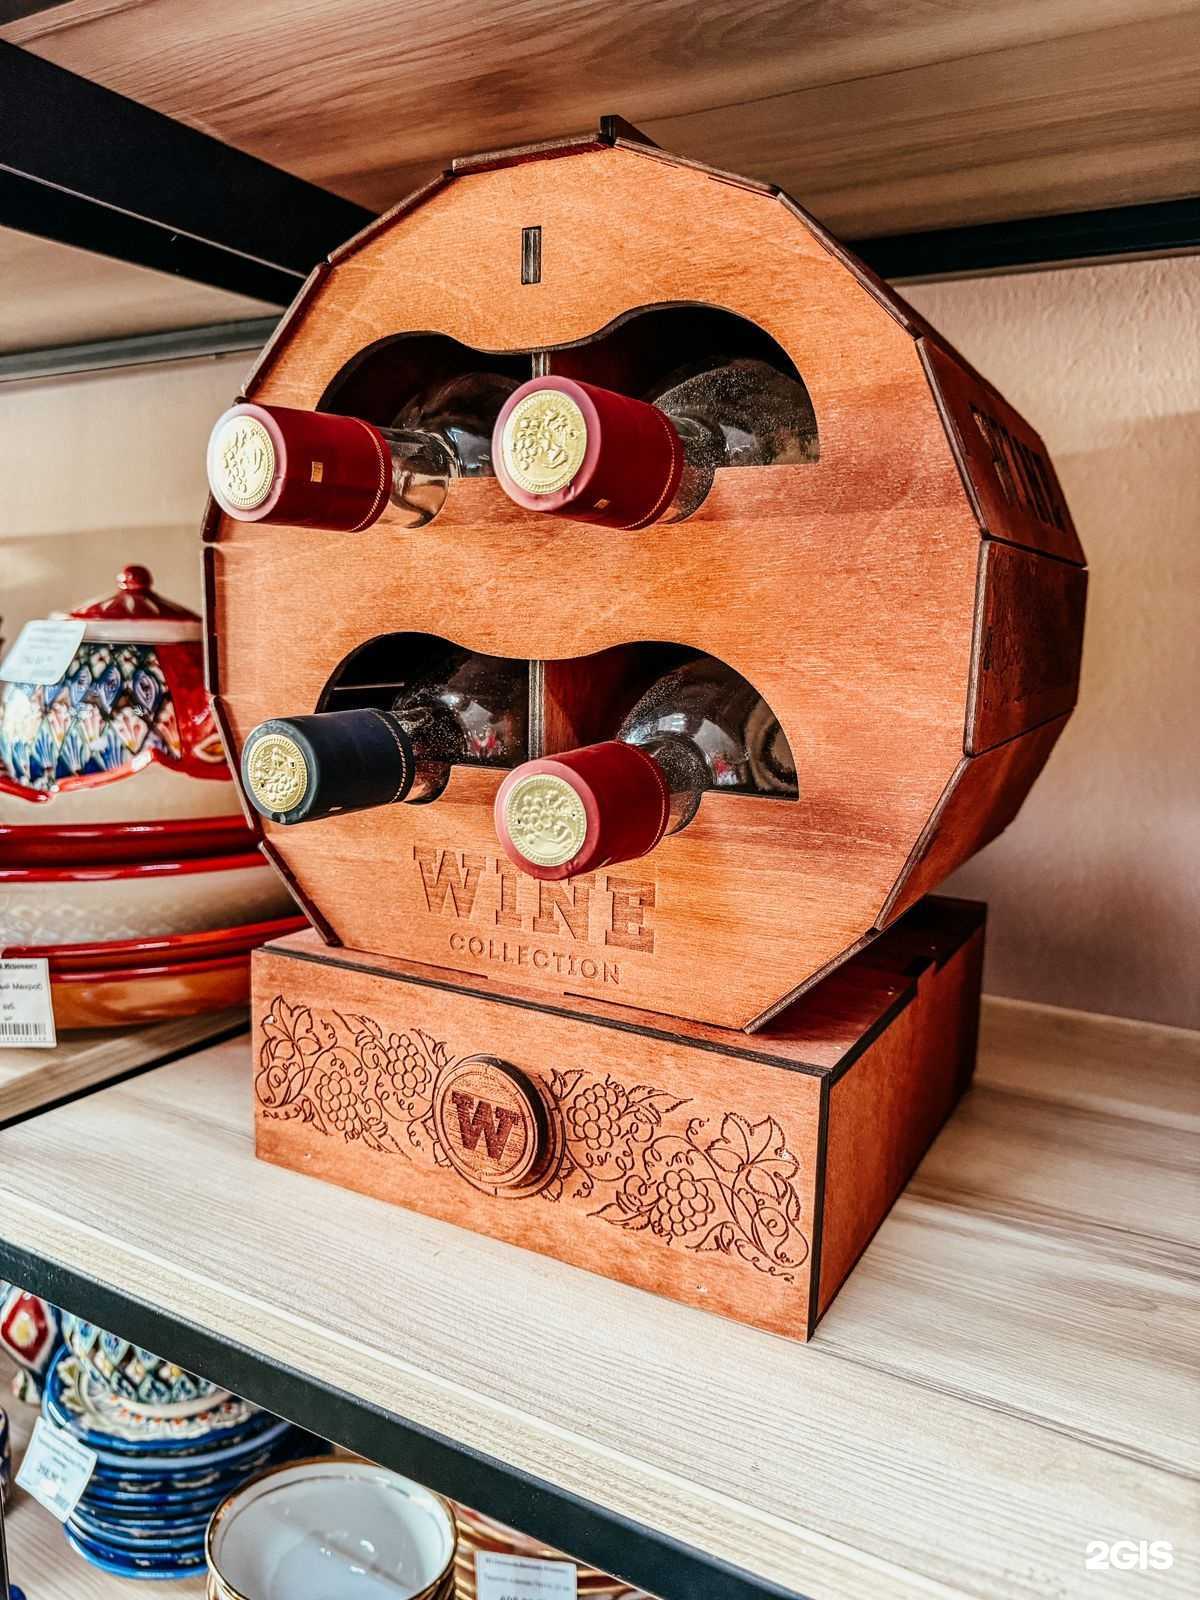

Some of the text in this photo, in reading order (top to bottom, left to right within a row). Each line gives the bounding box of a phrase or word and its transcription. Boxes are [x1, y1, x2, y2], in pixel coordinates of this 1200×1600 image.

[413, 846, 656, 953] WINE
[449, 932, 620, 985] COLLECTION
[451, 1090, 520, 1161] W
